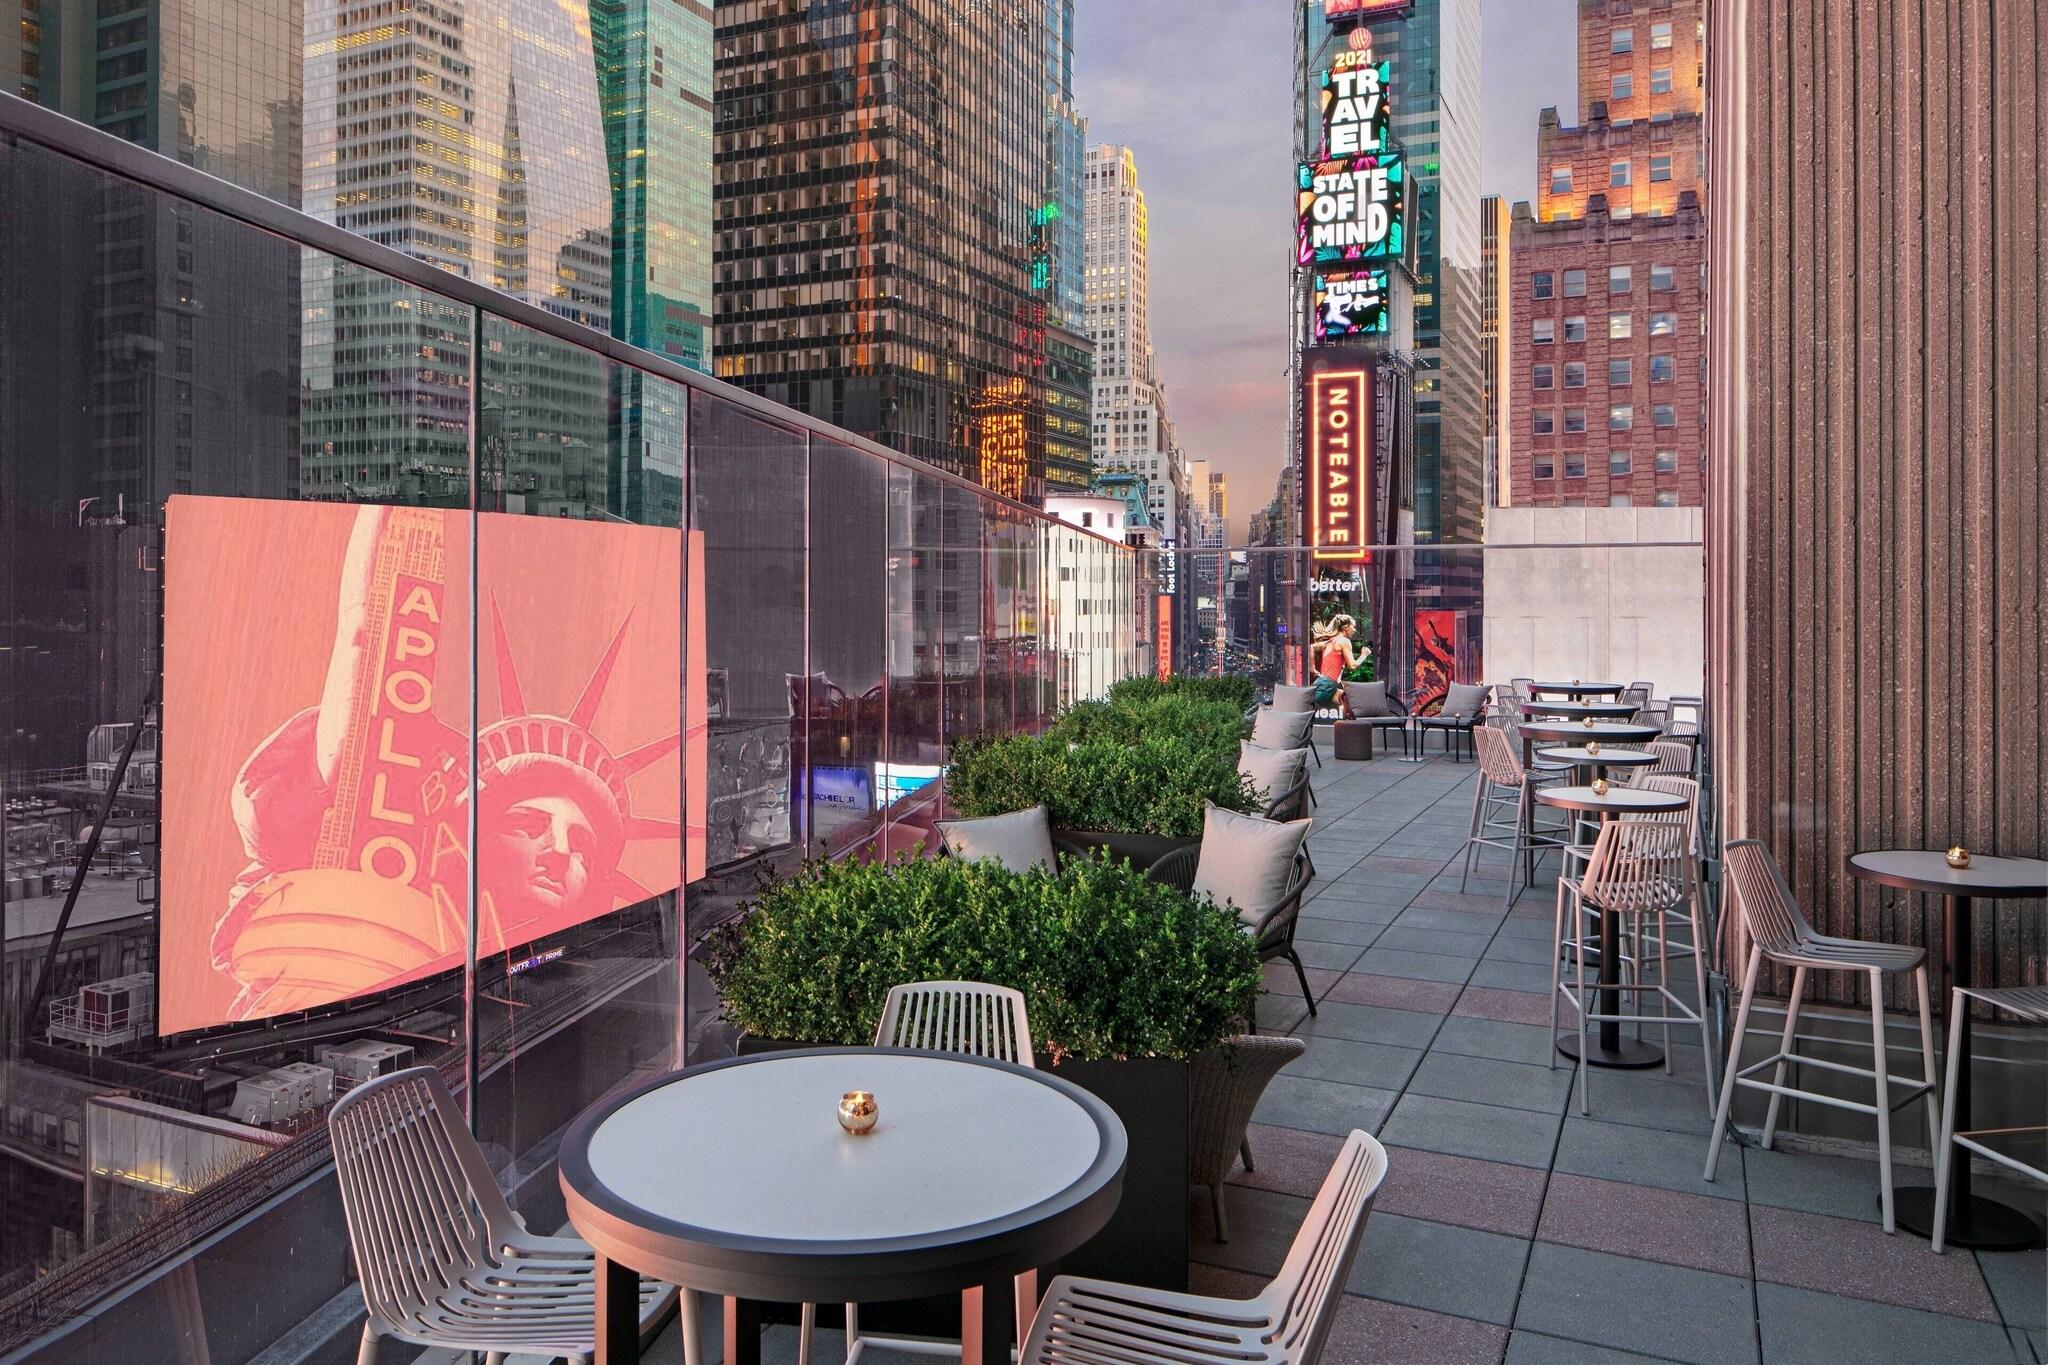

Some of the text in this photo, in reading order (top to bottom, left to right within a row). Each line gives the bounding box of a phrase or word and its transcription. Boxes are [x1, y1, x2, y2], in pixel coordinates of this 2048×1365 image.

[1335, 49, 1372, 67] 2021
[1313, 168, 1388, 219] STATE
[1313, 196, 1354, 222] OF
[1313, 202, 1388, 248] MIND
[1325, 278, 1379, 294] TIMES
[1329, 389, 1349, 542] NOTEABLE
[1166, 573, 1176, 593] Foot
[1310, 577, 1360, 592] better
[360, 586, 439, 886] APOLLO
[510, 955, 543, 975] OUTFRT
